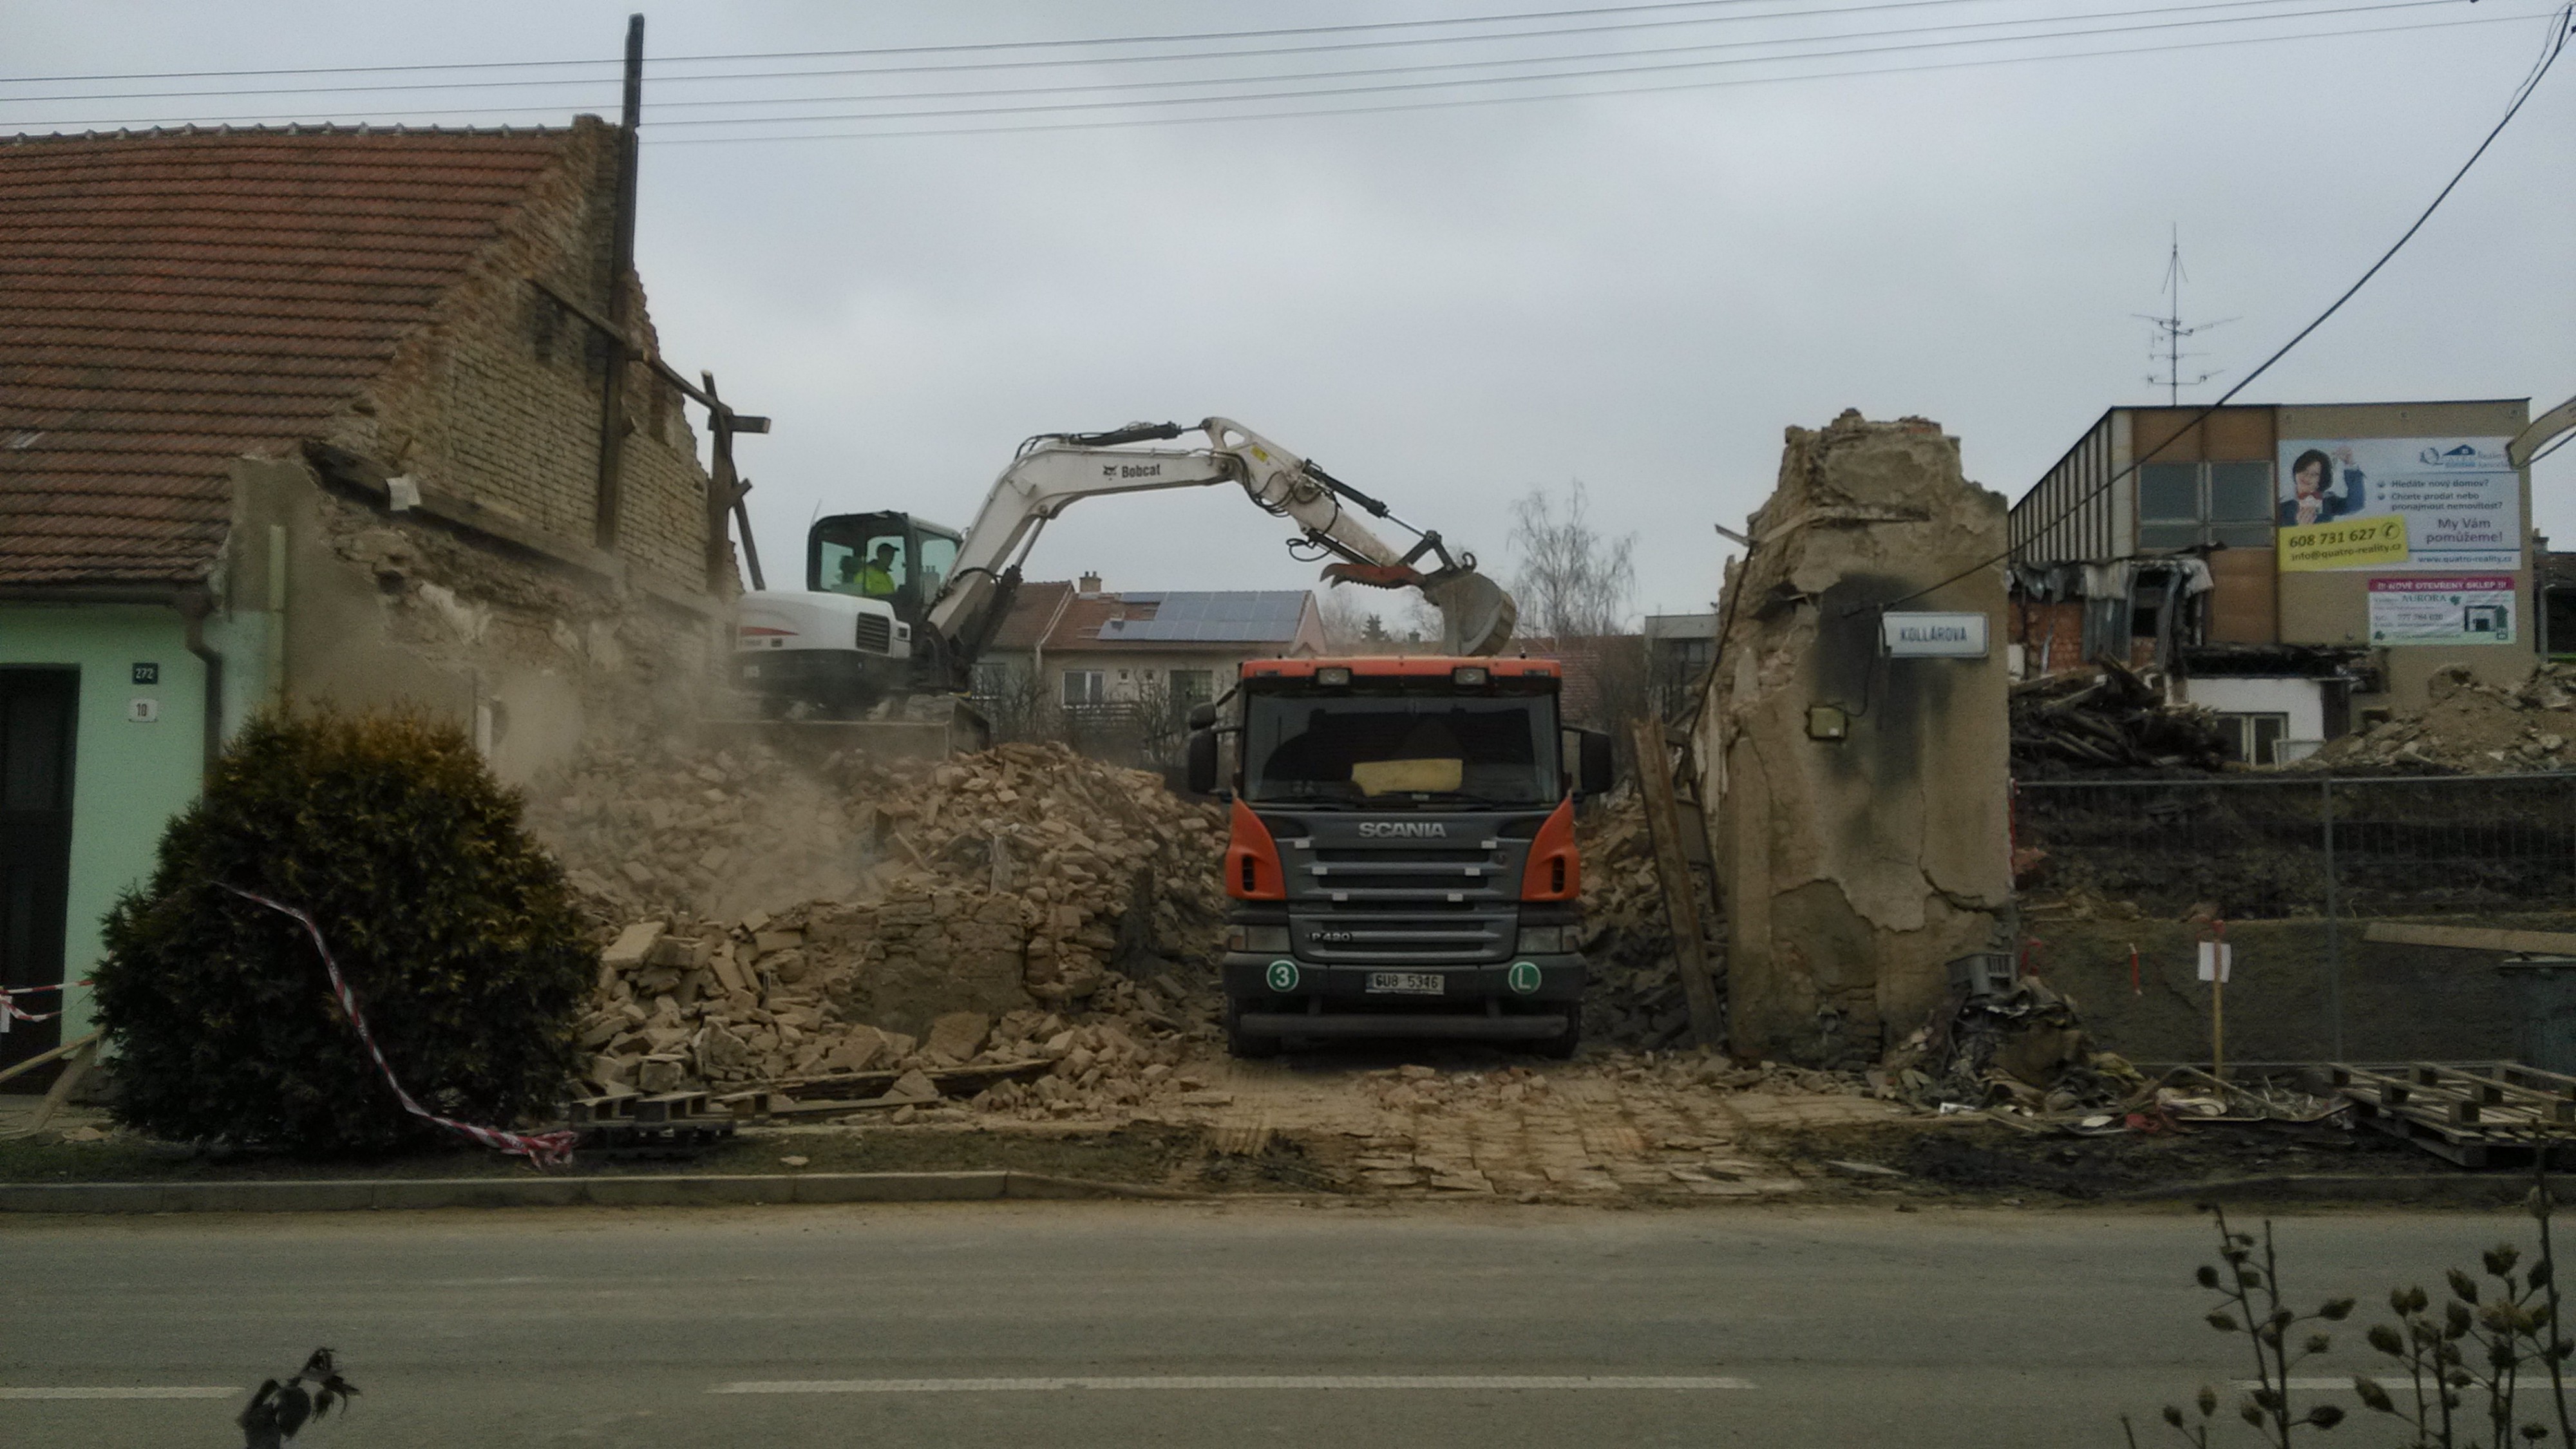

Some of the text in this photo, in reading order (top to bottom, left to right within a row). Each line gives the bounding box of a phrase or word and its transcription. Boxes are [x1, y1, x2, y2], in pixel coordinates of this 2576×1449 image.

[1122, 464, 1160, 478] Bobcat
[2429, 480, 2449, 488] nový
[2424, 493, 2454, 501] prodat
[2438, 518, 2491, 530] My Vám
[2289, 528, 2376, 548] 608 731 627
[2427, 531, 2503, 544] pomůžeme!
[2291, 543, 2401, 562] info@quatro-reality.cz
[135, 668, 153, 679] 272
[137, 703, 147, 716] 10
[1359, 822, 1446, 838] SCANIA
[1276, 966, 1290, 987] 3
[1519, 970, 1531, 989] L
